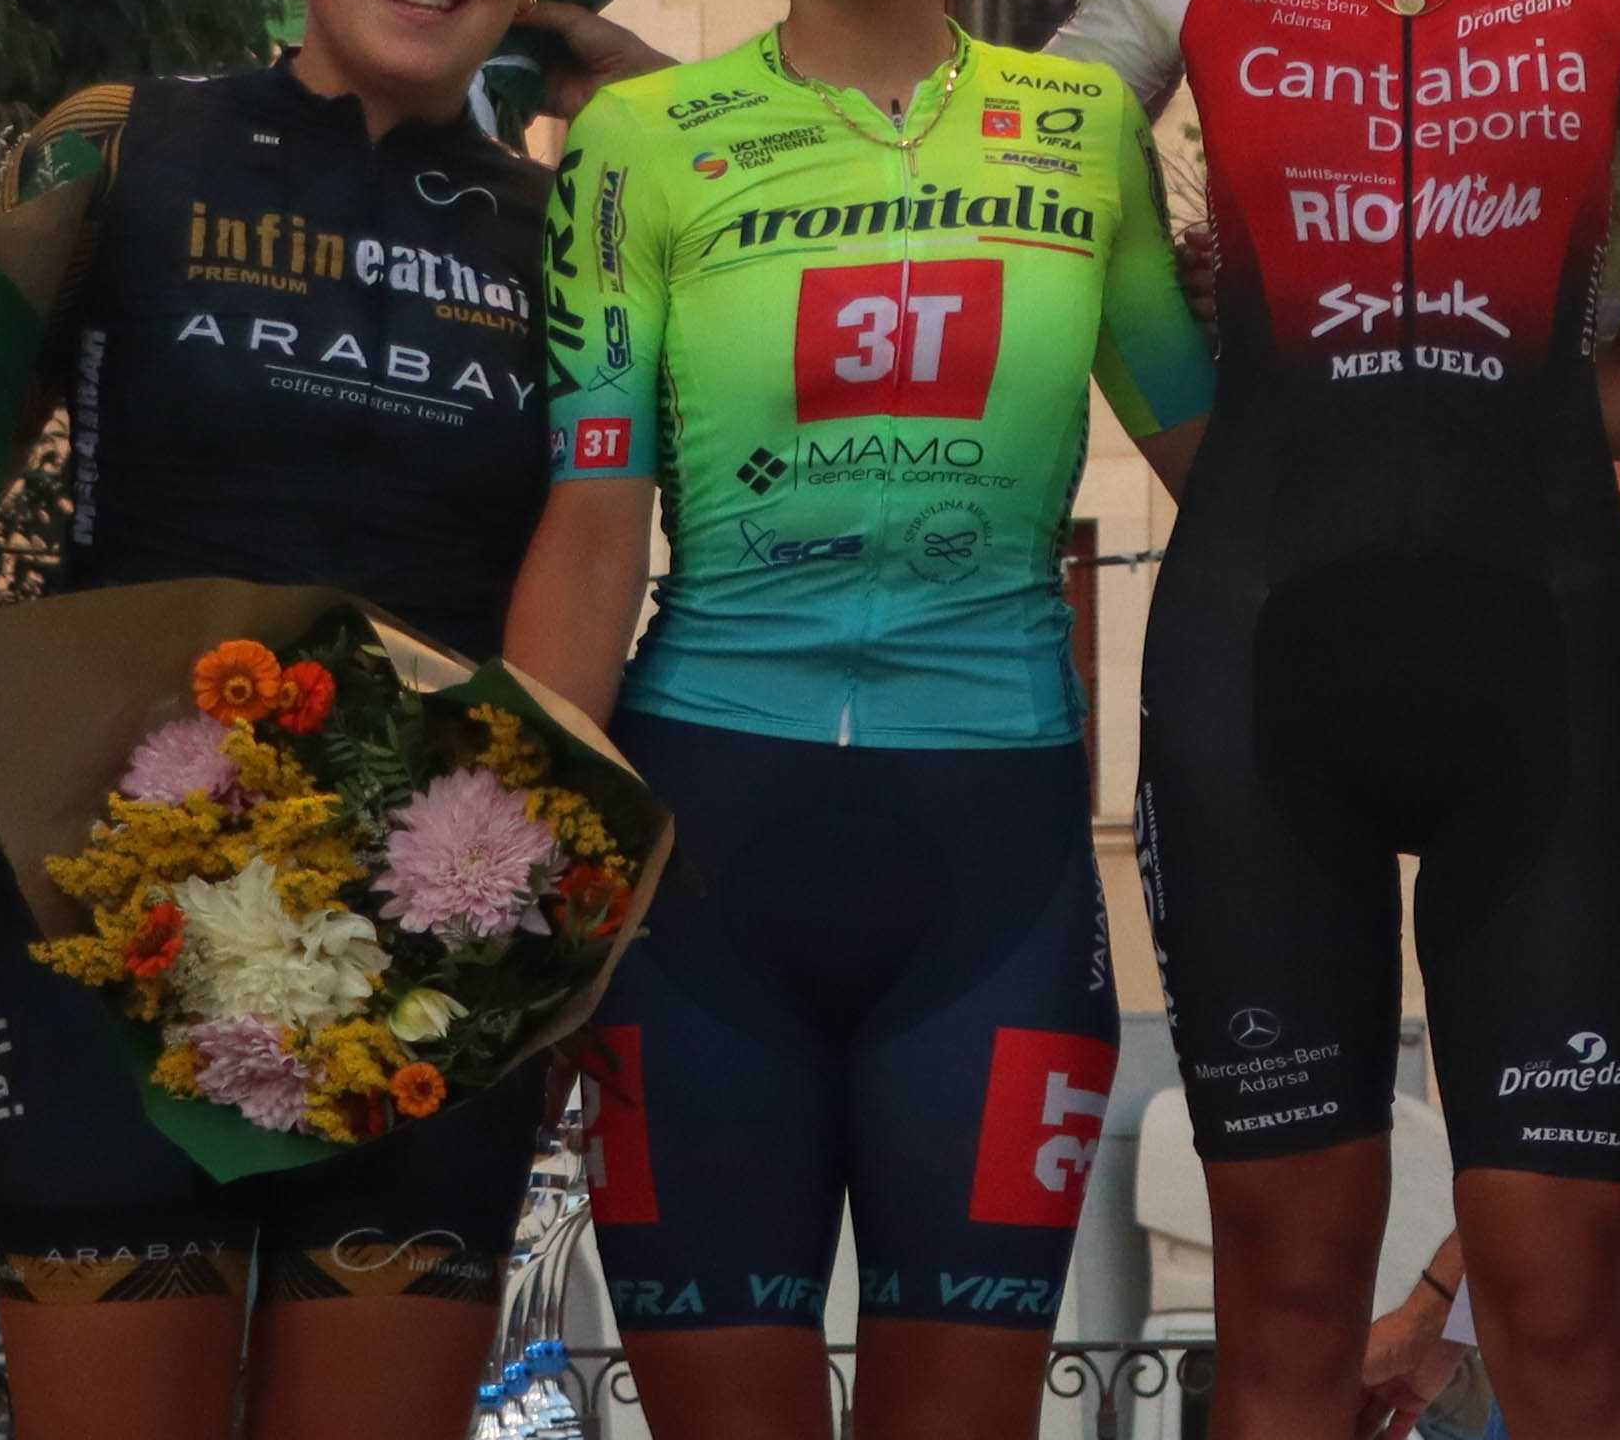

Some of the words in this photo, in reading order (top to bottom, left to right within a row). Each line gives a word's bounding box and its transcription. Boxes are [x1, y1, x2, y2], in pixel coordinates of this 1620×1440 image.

[1270, 8, 1333, 32] Adarsa
[1000, 70, 1103, 98] VAIANO
[1237, 37, 1588, 110] Cantabria
[728, 140, 757, 154] UCI
[758, 124, 826, 148] WOMEN'S
[1036, 135, 1084, 151] VIFRA
[1366, 102, 1583, 157] Deporte
[734, 135, 829, 163] CONTINENTAL
[738, 155, 775, 171] TEAM
[1284, 165, 1398, 185] MultiServicios
[701, 182, 1096, 258] Aromitalia
[1288, 182, 1406, 245] RÍO
[1411, 172, 1543, 242] Miera
[187, 264, 308, 295] PREMIUM
[435, 303, 533, 338] QUALITY
[1310, 278, 1511, 339] Spiuk
[833, 294, 964, 383] 3T
[175, 313, 537, 412] ARABAY
[1329, 346, 1506, 381] MERUELO
[270, 375, 334, 399] coffee
[339, 385, 411, 417] roasters
[417, 400, 465, 427] team
[583, 428, 622, 458] 3T
[808, 435, 984, 469] MAMO
[1195, 1042, 1341, 1080] Mercedes-Benz
[1237, 1067, 1310, 1095] Adarsa
[1035, 1071, 1110, 1194] 3T
[1224, 1100, 1341, 1134] MERUELO
[43, 1240, 228, 1265] ARABAY
